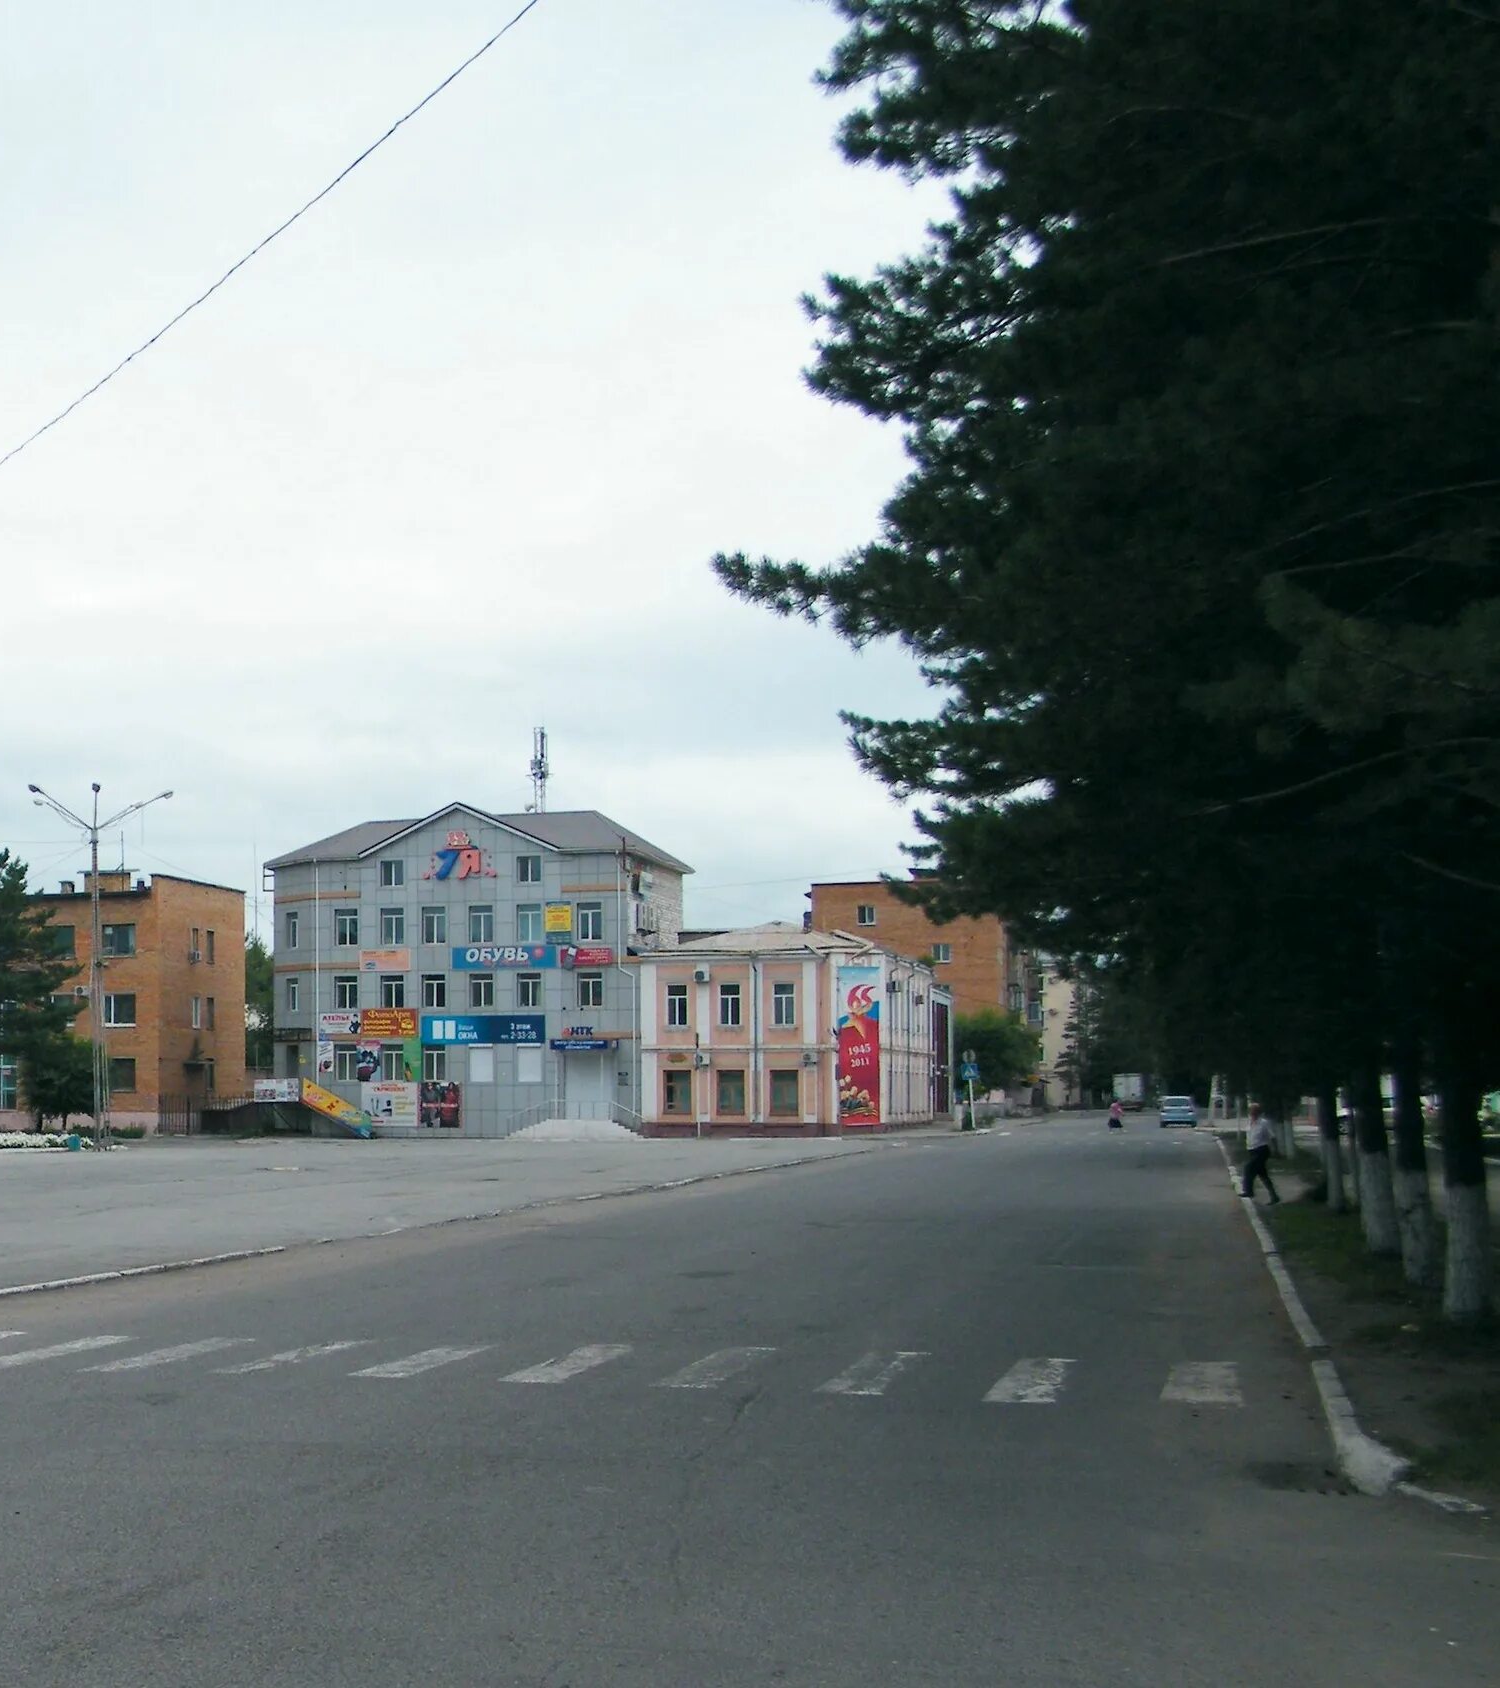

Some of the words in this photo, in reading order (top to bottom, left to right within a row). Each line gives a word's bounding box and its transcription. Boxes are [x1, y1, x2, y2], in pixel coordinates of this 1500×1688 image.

[436, 849, 481, 881] 7Я
[465, 947, 529, 963] ОБУВЬ
[458, 1032, 478, 1040] ОКНА
[848, 1043, 872, 1056] 1945
[851, 1057, 870, 1068] 2011
